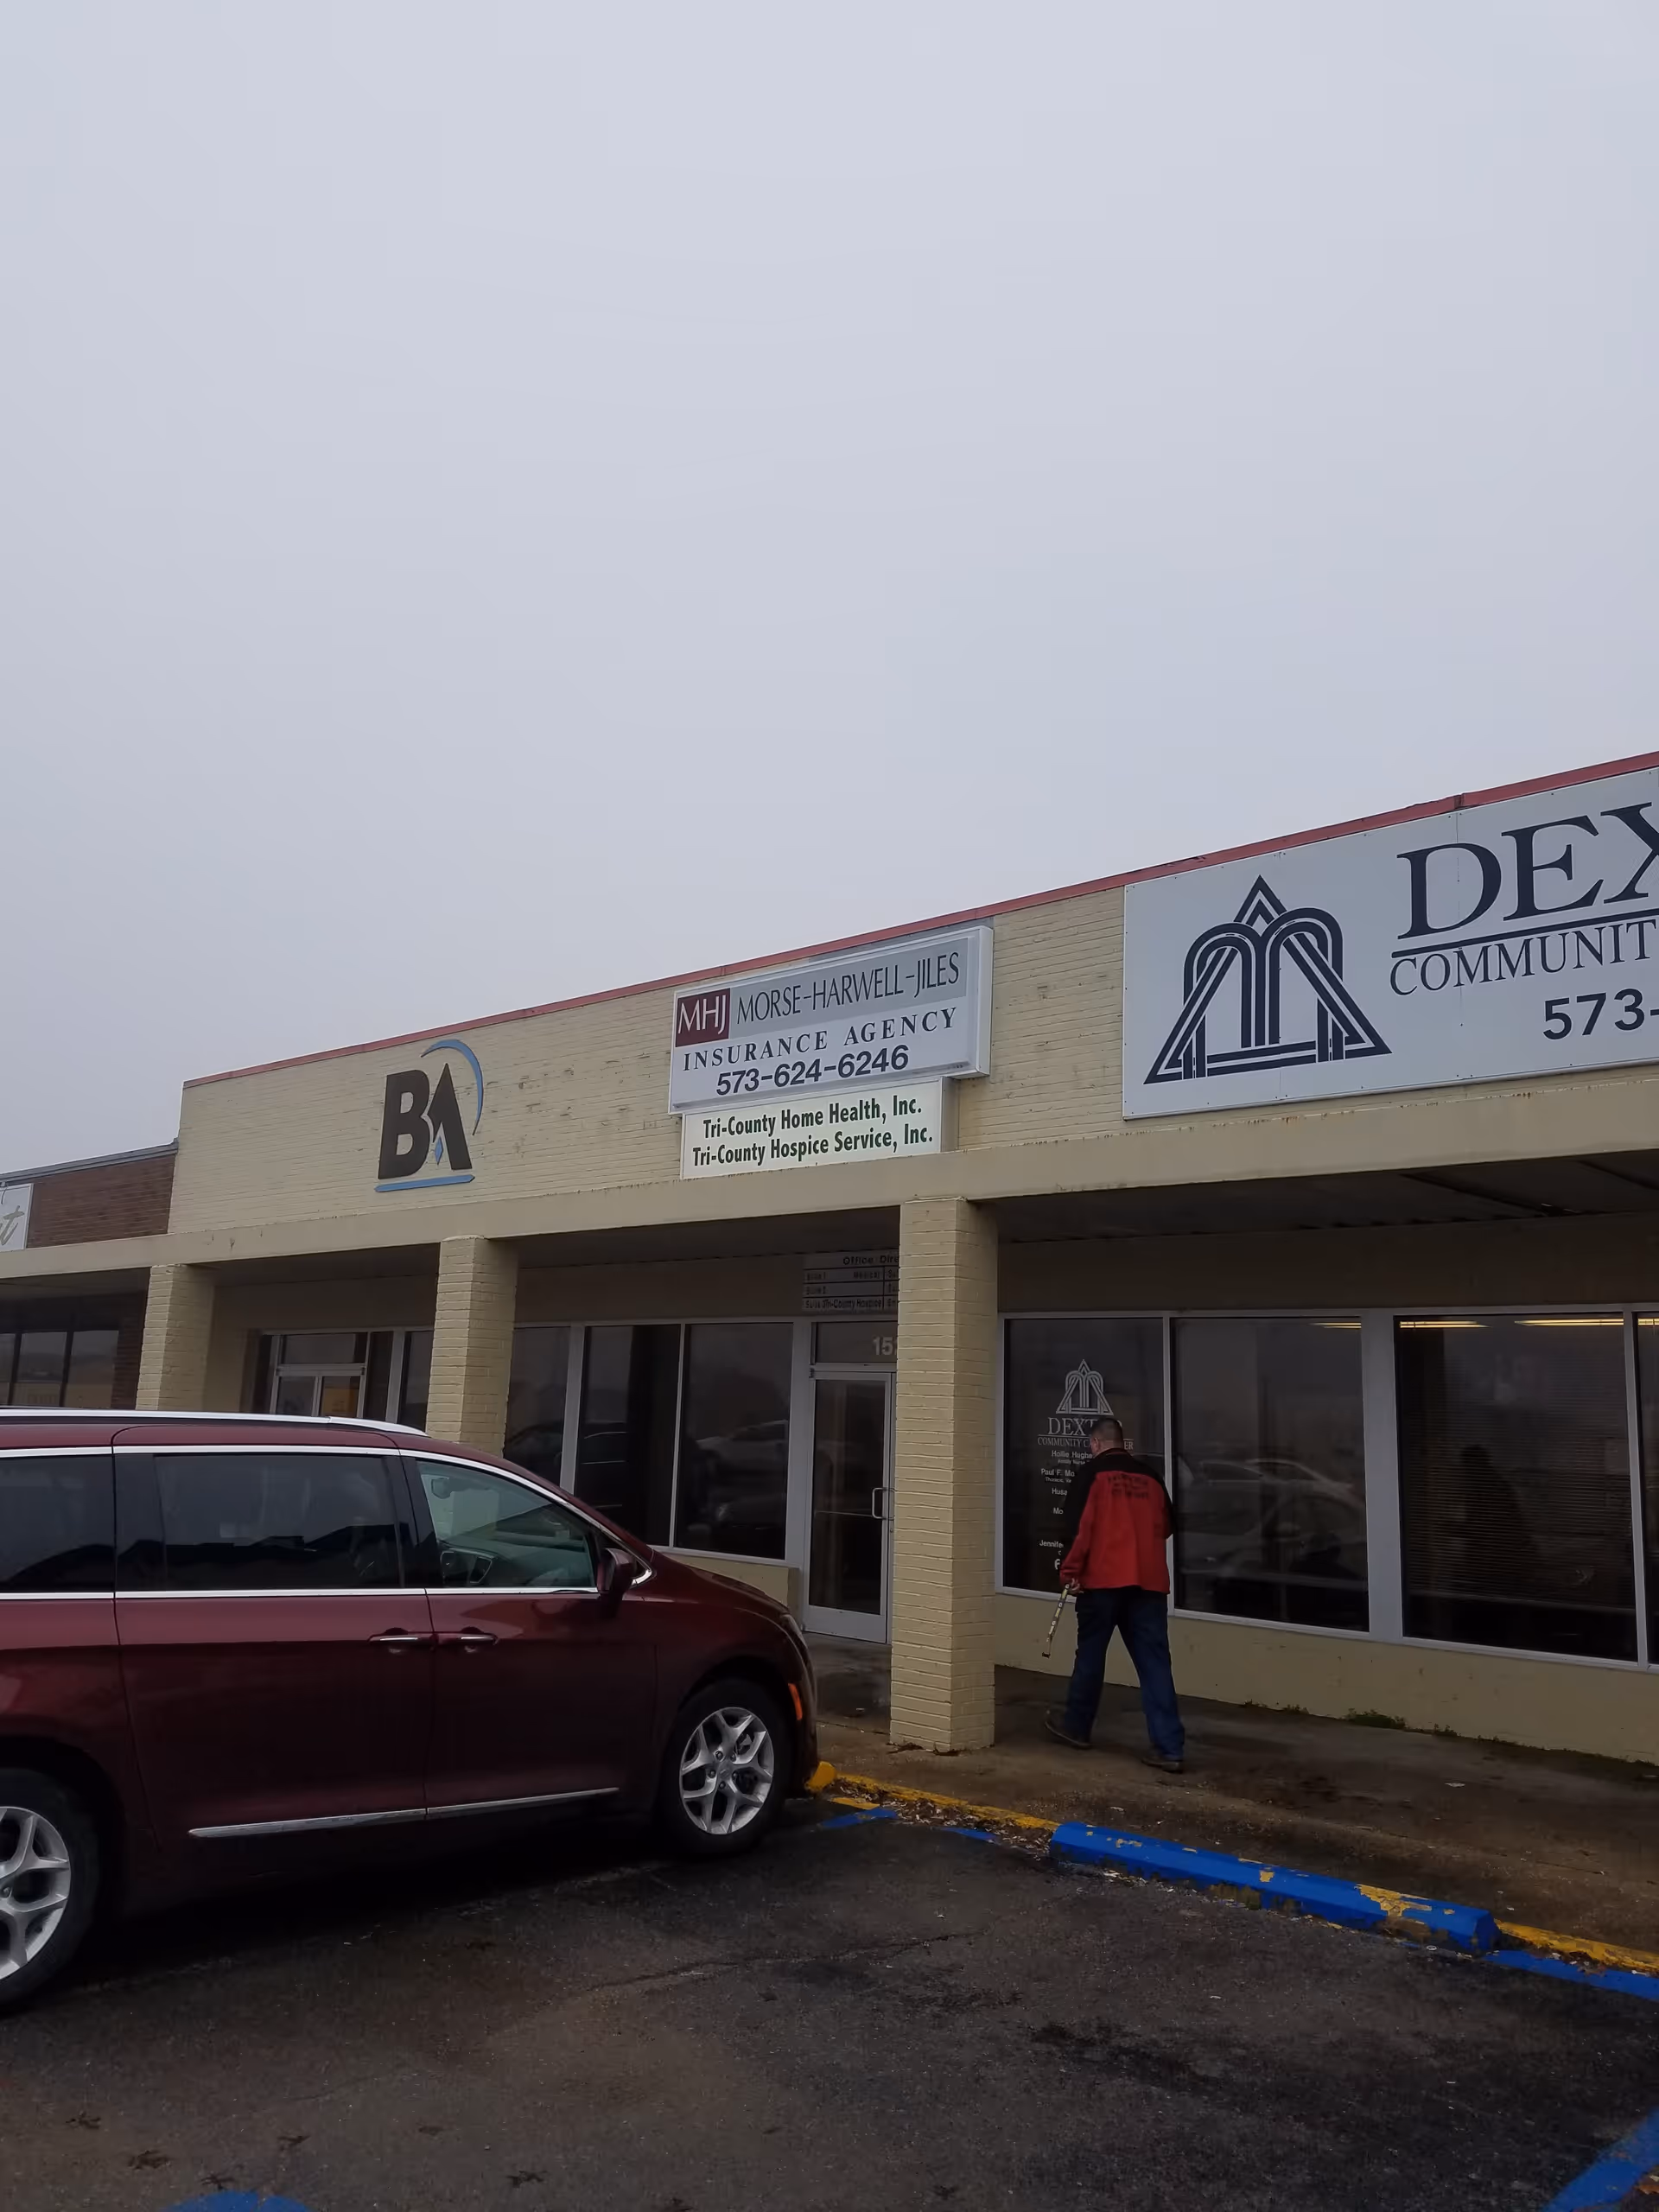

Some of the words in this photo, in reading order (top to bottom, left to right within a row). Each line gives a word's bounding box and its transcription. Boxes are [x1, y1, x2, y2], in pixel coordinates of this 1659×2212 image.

[677, 995, 727, 1035] MHJ
[683, 1029, 829, 1071] INSURANCE
[843, 1007, 957, 1046] AGENCY
[715, 1044, 910, 1096] 573-624-6246
[378, 1063, 473, 1179] BA
[702, 1111, 776, 1140] Tri-County
[780, 1107, 823, 1130] Home
[829, 1097, 887, 1124] Health,
[893, 1095, 922, 1115] Inc.
[692, 1138, 766, 1166] Tri-County
[770, 1134, 829, 1161] Hospice
[835, 1127, 898, 1152] Service,
[904, 1123, 933, 1145] Inc.
[842, 1255, 874, 1266] Office
[872, 1336, 897, 1356] 15
[1038, 1436, 1083, 1447] COMMUNITY
